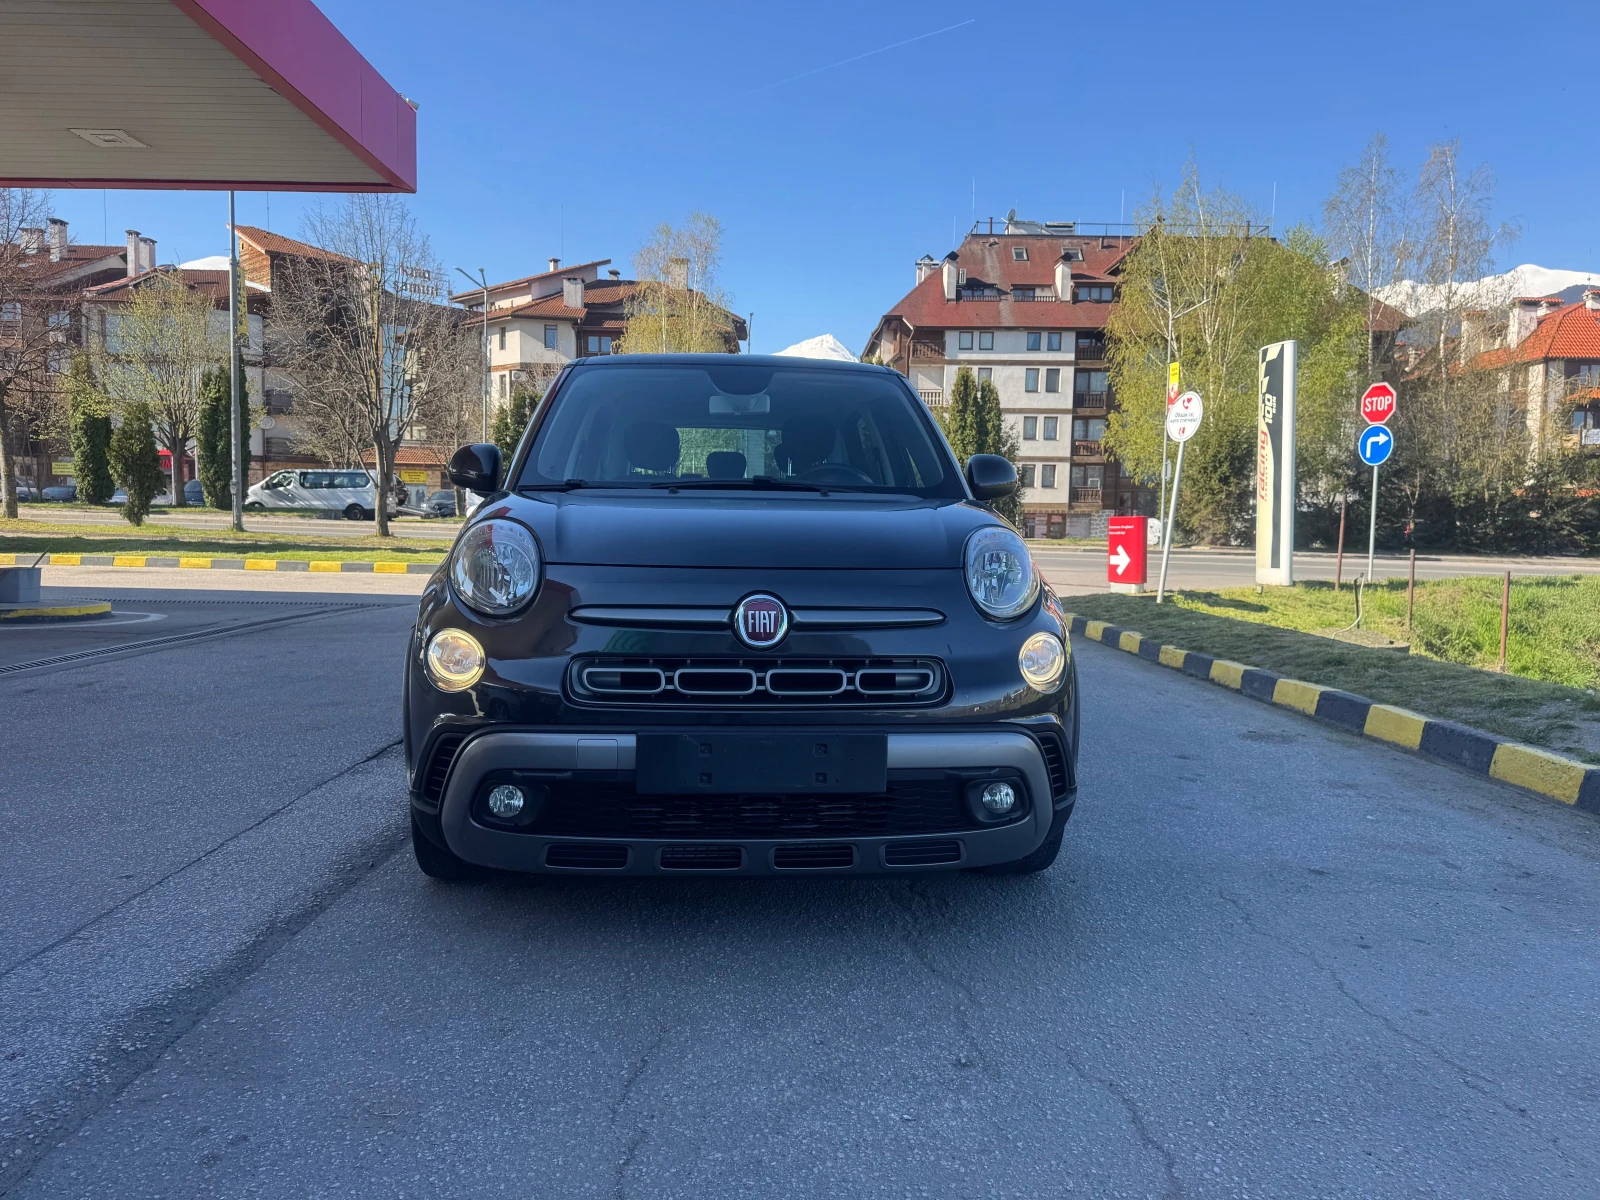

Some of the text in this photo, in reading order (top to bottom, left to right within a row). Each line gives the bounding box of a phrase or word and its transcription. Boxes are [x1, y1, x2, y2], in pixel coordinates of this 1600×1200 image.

[1264, 393, 1273, 424] 100
[1364, 395, 1392, 412] STOP
[1258, 430, 1268, 500] racing
[747, 610, 777, 633] FIAT
